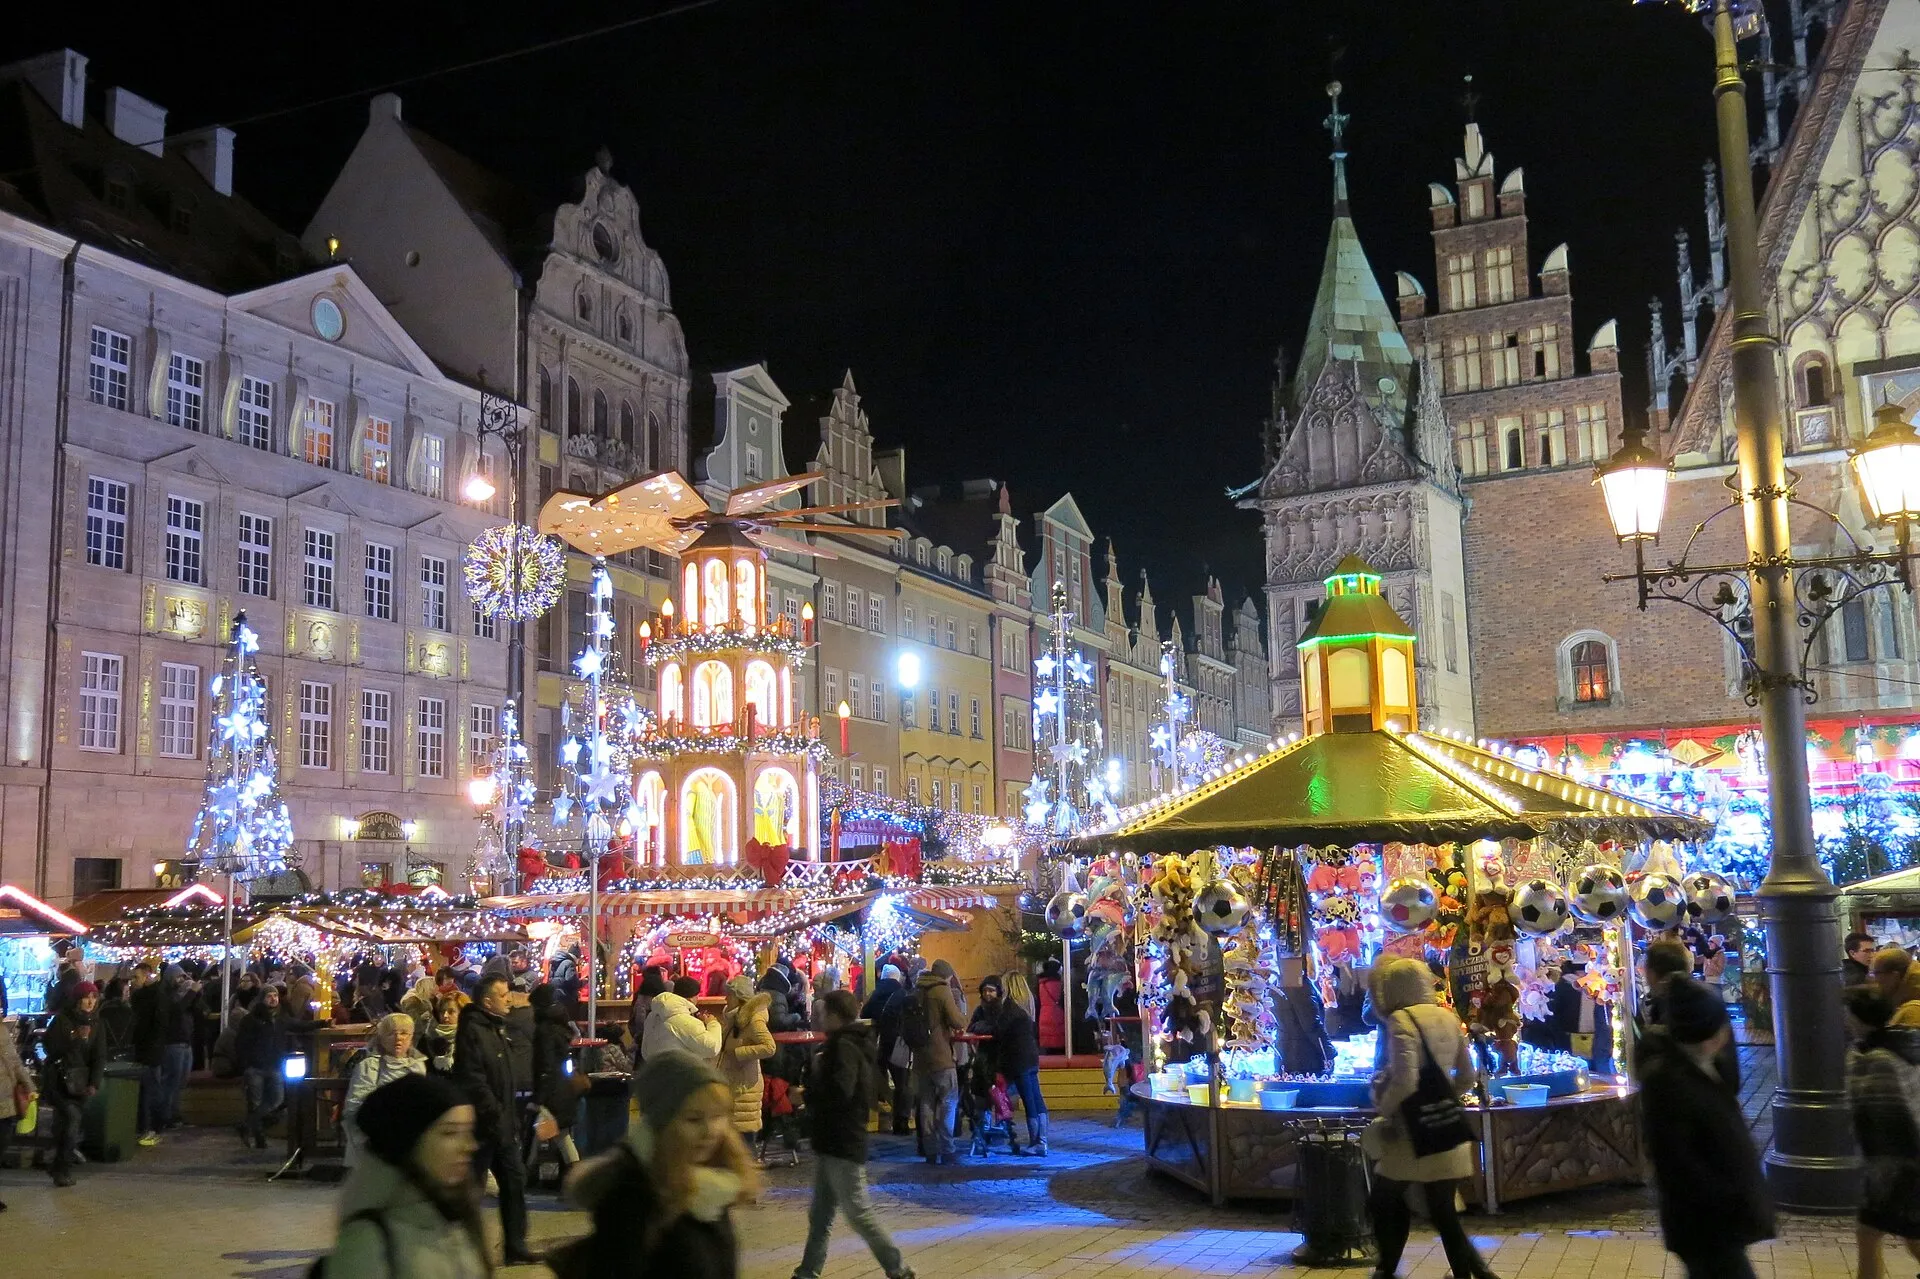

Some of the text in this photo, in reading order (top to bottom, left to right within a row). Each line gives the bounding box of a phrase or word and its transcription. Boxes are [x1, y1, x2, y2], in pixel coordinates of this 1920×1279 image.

[161, 873, 181, 889] 26
[676, 934, 706, 942] Grzaniec
[1470, 973, 1482, 982] CO
